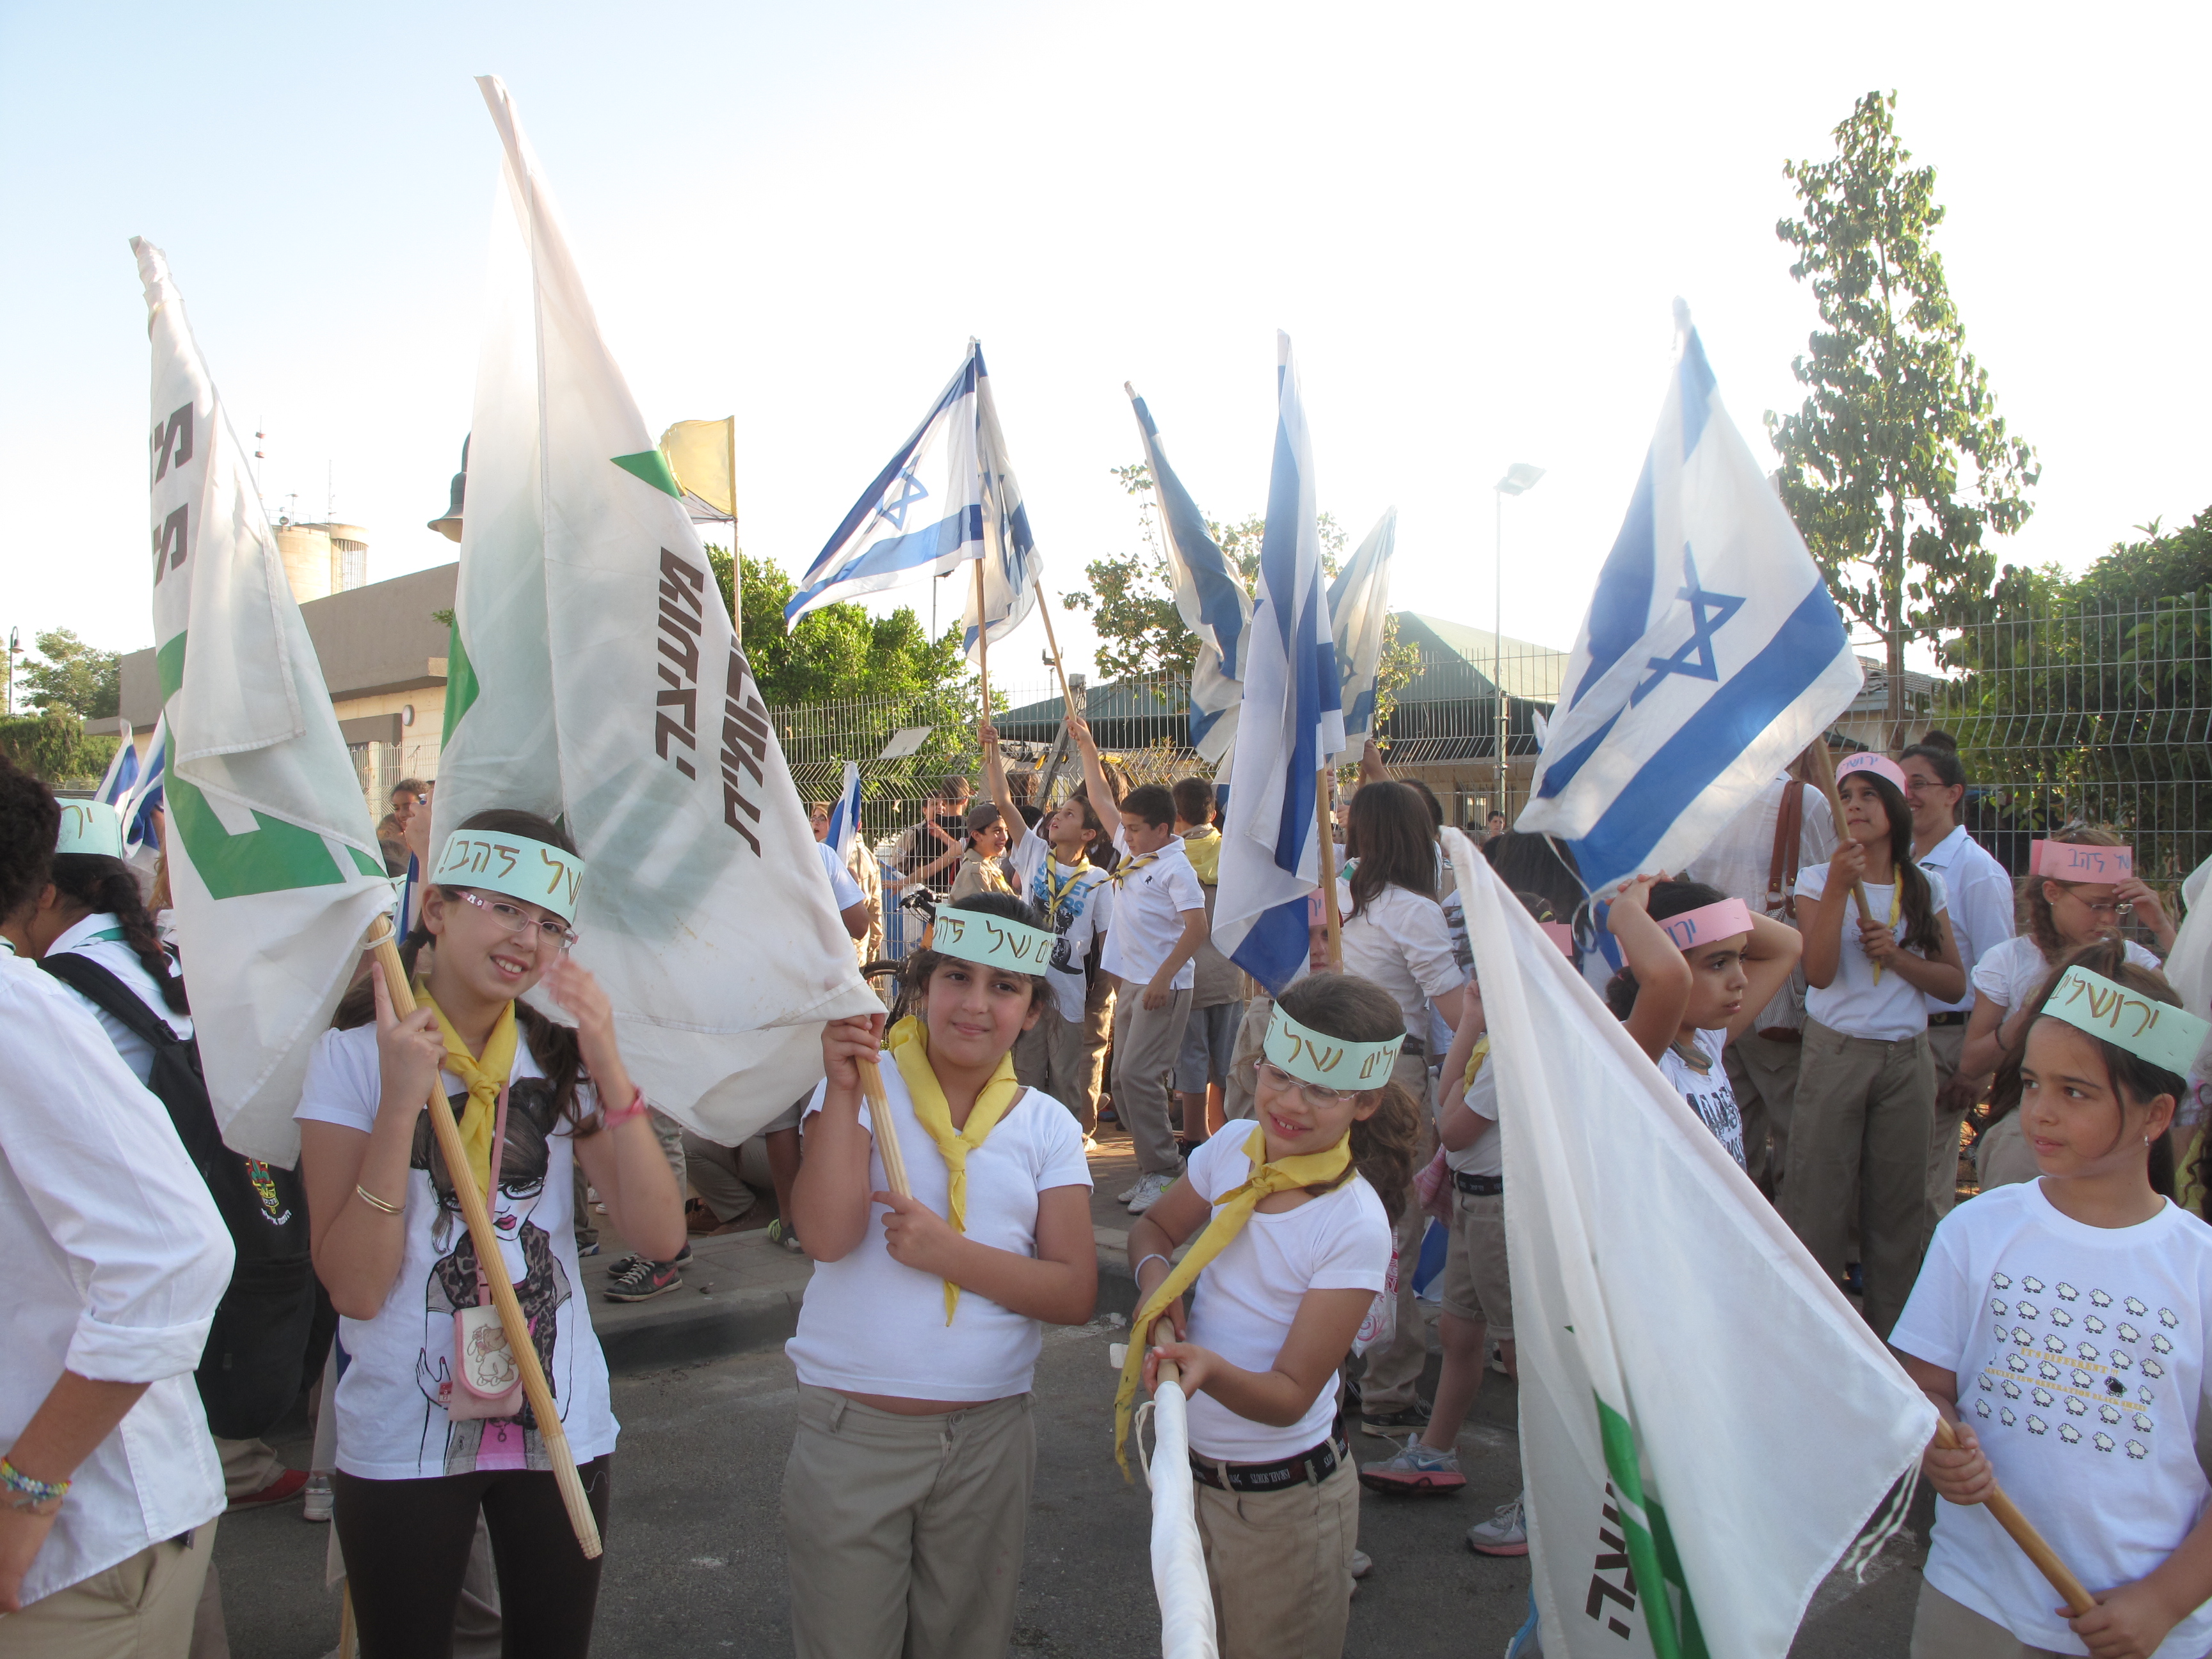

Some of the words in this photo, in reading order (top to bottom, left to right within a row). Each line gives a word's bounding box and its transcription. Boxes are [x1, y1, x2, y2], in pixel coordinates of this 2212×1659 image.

[655, 547, 703, 781] מועצה
[720, 634, 770, 858] קומית
[540, 848, 582, 906] של
[986, 920, 1031, 959] של
[1284, 1022, 1343, 1072] של
[2044, 1352, 2108, 1374] DIFFERENT
[2093, 1391, 2120, 1406] BLACK
[1269, 1468, 1290, 1483] ISRAEL
